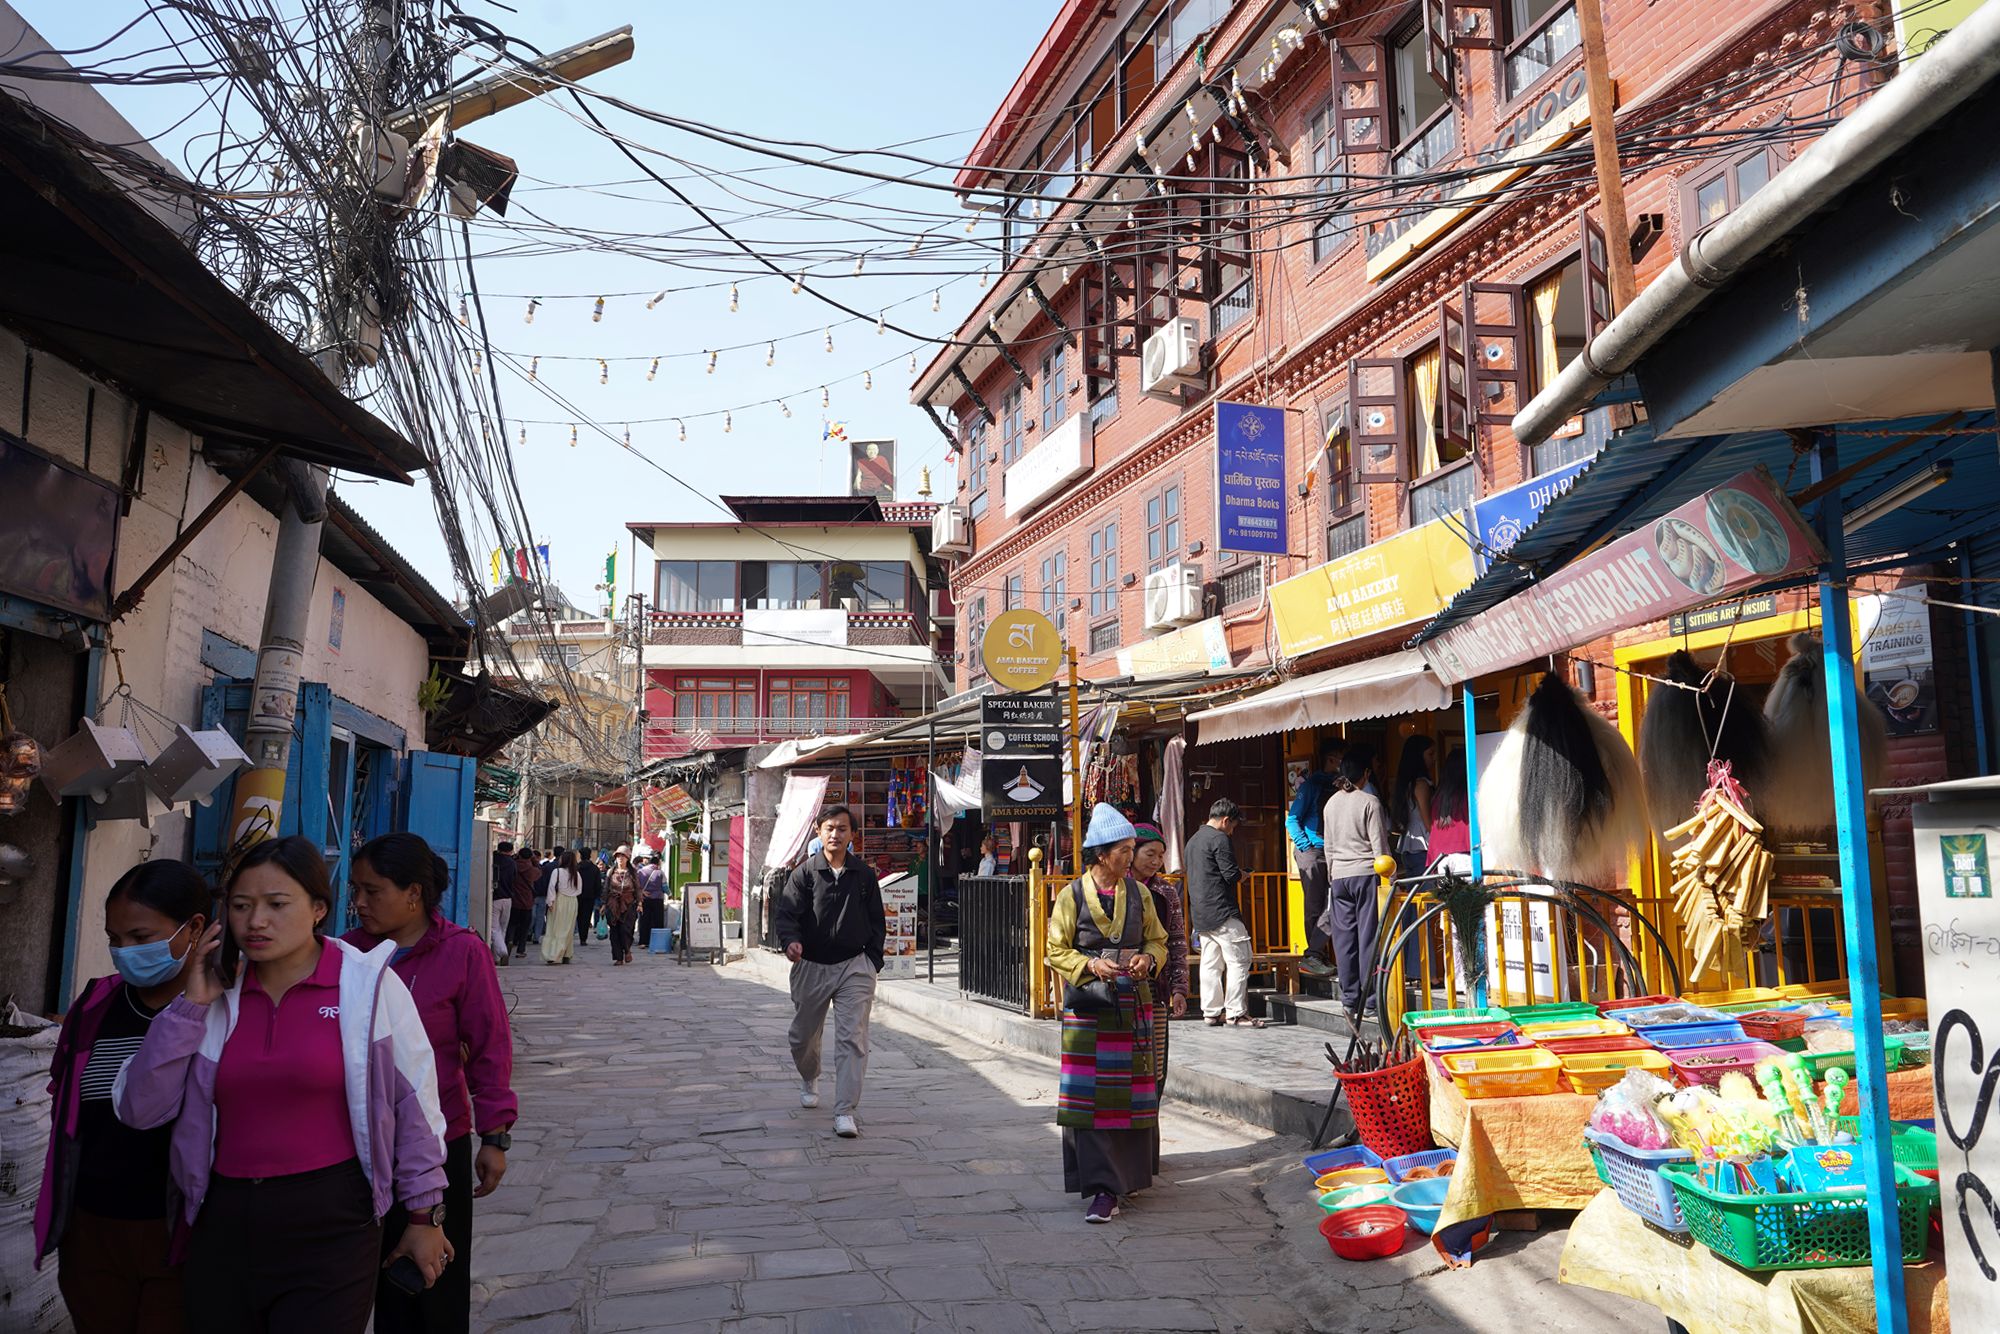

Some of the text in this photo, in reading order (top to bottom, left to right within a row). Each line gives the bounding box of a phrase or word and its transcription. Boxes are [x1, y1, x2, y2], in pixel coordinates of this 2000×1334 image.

[1477, 68, 1587, 166] SCHOO
[1225, 494, 1281, 511] Dharma Books
[1228, 528, 1239, 537] Ph:
[1327, 574, 1400, 614] AMA BAKERY
[1534, 547, 1673, 640] RESTAURANT
[1688, 610, 1719, 628] SITTING
[1742, 599, 1772, 616] INSIDE
[1868, 633, 1924, 652] TRAINING
[996, 656, 1049, 665] AMA BAKERY
[1173, 649, 1199, 668] SHOP
[987, 701, 1056, 709] SPECIAL BAKERY
[1008, 733, 1032, 742] COFFEE
[1033, 733, 1060, 742] SCHOOL
[991, 807, 1058, 816] AMA ROOFTOP
